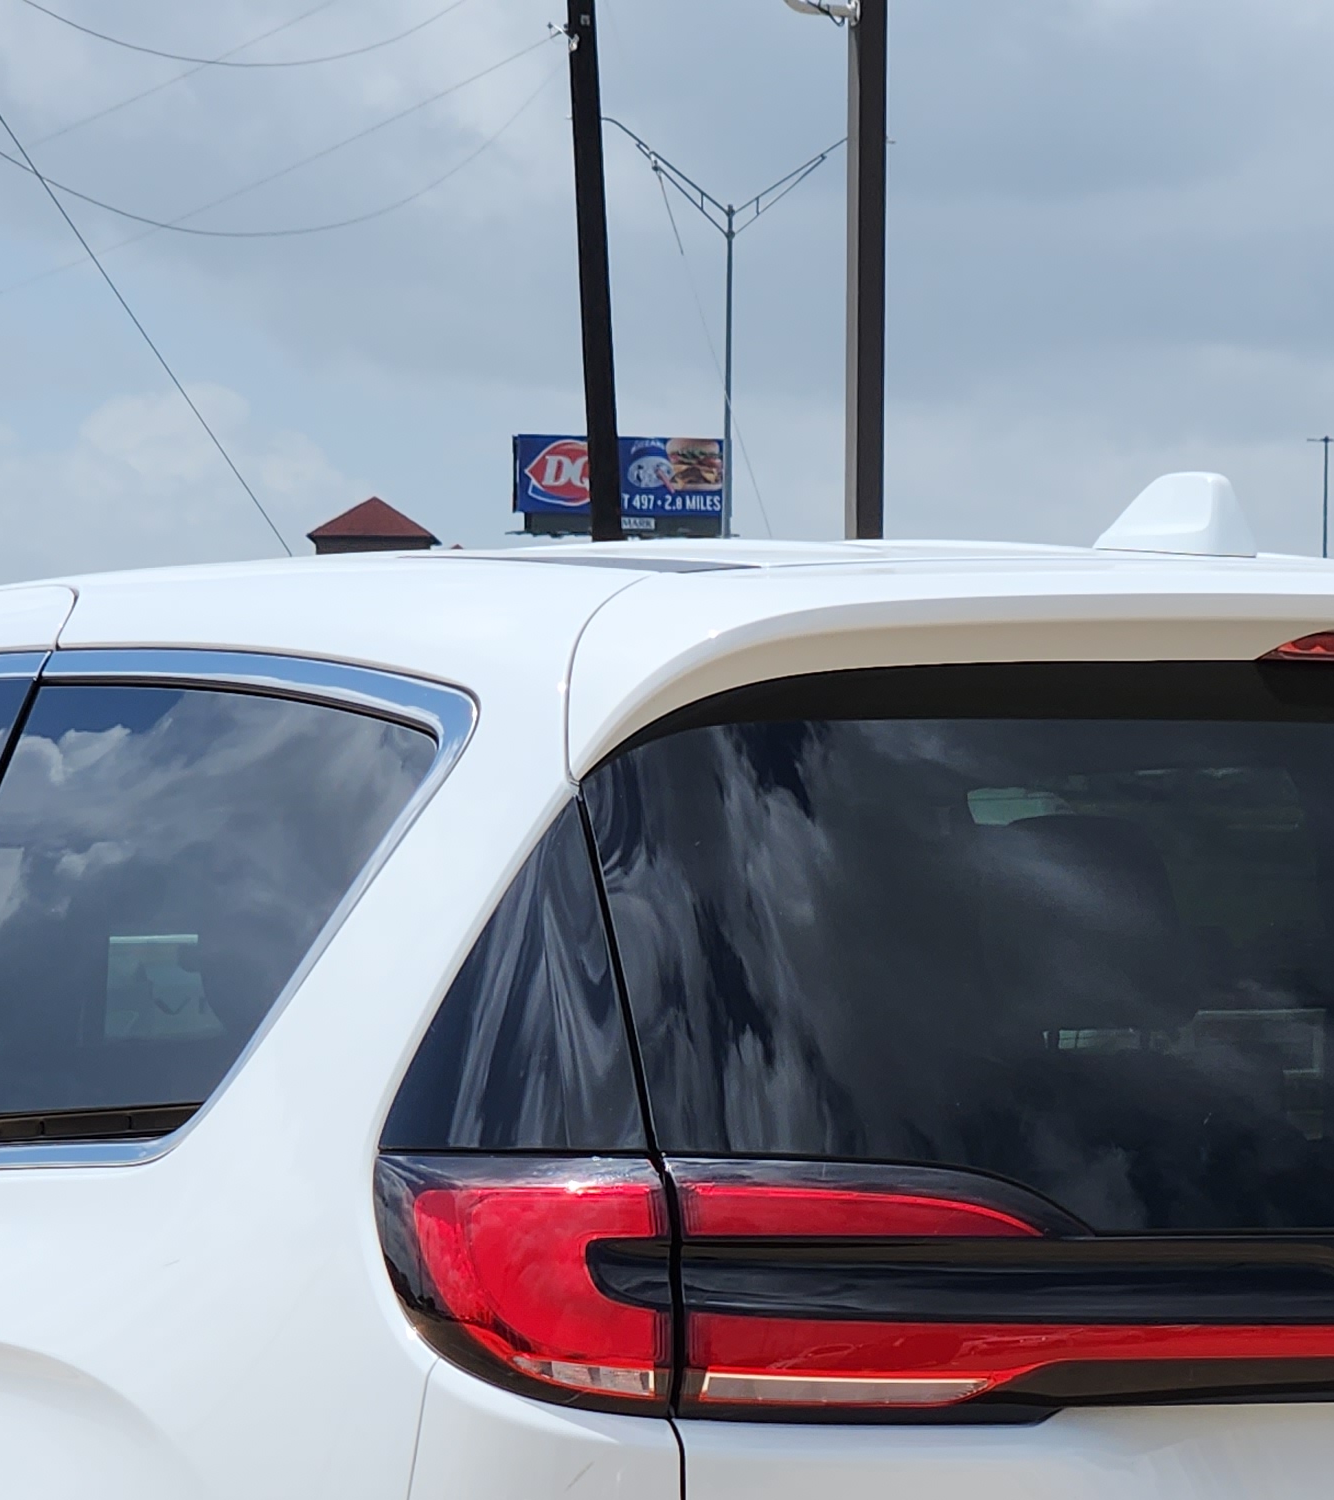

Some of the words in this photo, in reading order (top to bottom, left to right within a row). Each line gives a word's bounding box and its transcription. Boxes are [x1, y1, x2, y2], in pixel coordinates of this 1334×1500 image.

[632, 494, 655, 510] 497
[664, 495, 683, 510] 2.8
[685, 495, 721, 511] MILES
